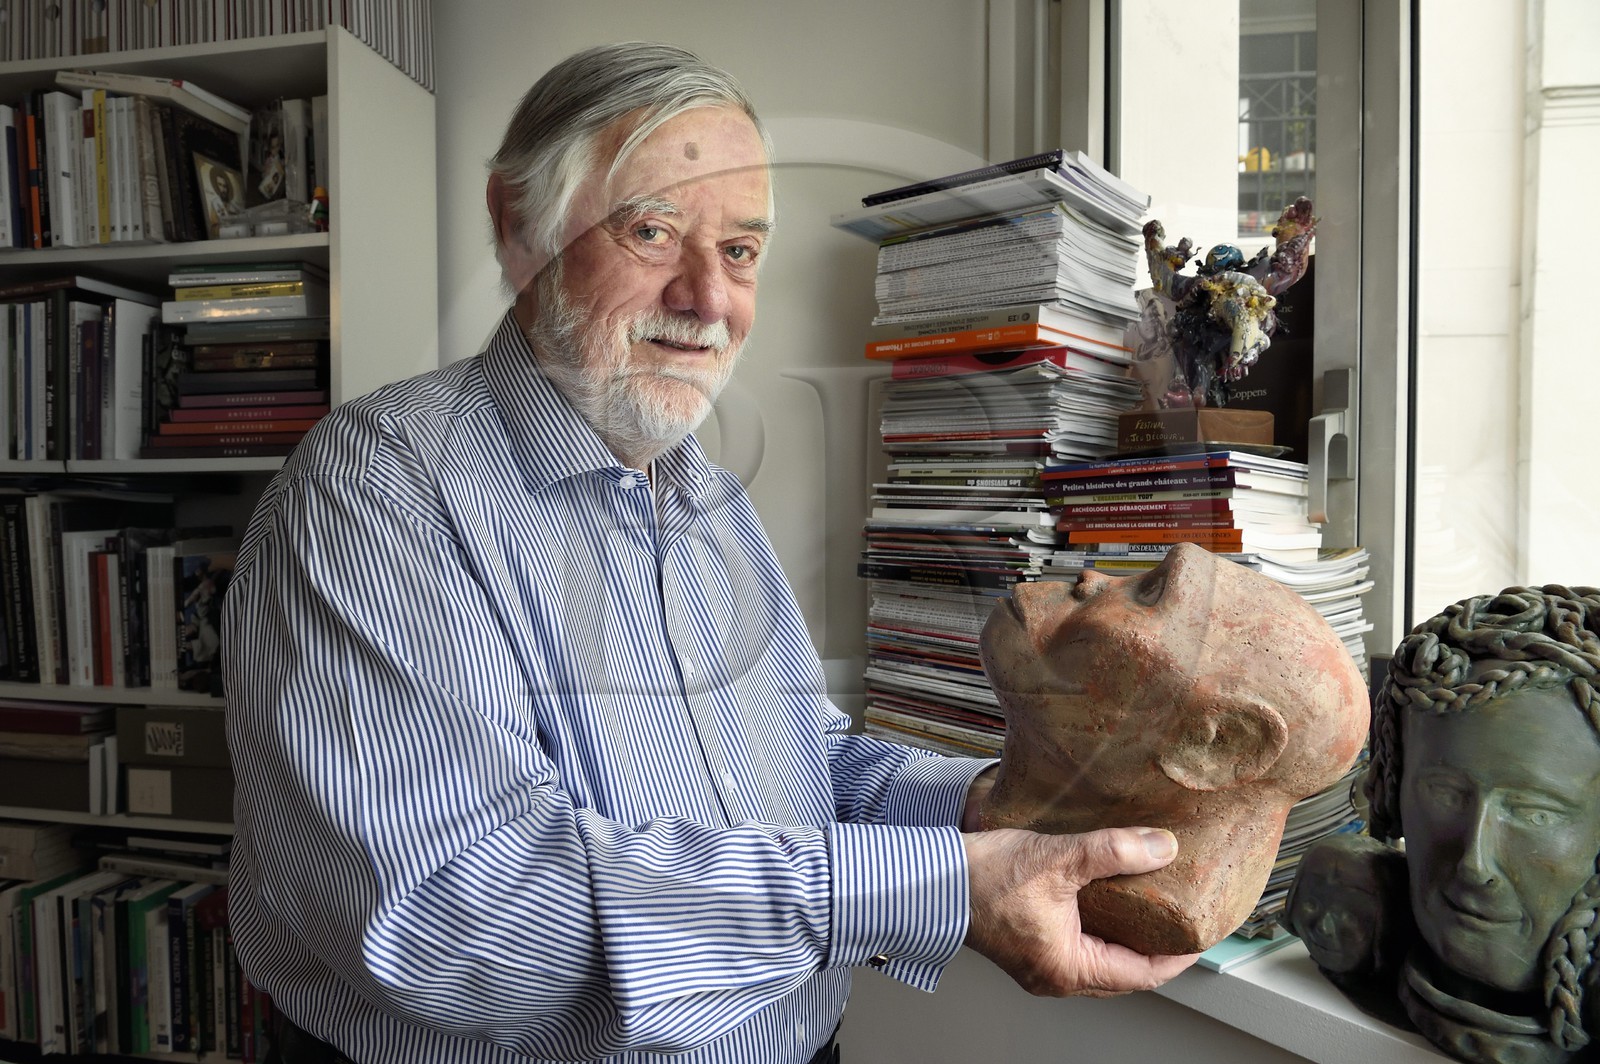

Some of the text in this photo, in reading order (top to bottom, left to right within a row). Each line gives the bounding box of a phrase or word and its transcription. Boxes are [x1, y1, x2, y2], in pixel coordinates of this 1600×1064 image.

[875, 344, 903, 352] l'Homme
[47, 392, 53, 401] de
[976, 479, 1008, 487] DIVISIONS
[1086, 482, 1114, 490] histoires
[1128, 480, 1152, 489] grands
[1154, 477, 1188, 486] châteaux
[1072, 505, 1109, 513] ARCHÉOLOGIE
[1119, 504, 1167, 512] DÉBARQUEMENT
[8, 520, 17, 551] MONGOLIE
[11, 552, 18, 561] EN
[12, 562, 21, 588] STEPPES
[14, 588, 22, 601] DES
[17, 626, 25, 653] PREMIER
[173, 988, 182, 1024] ROUTIER
